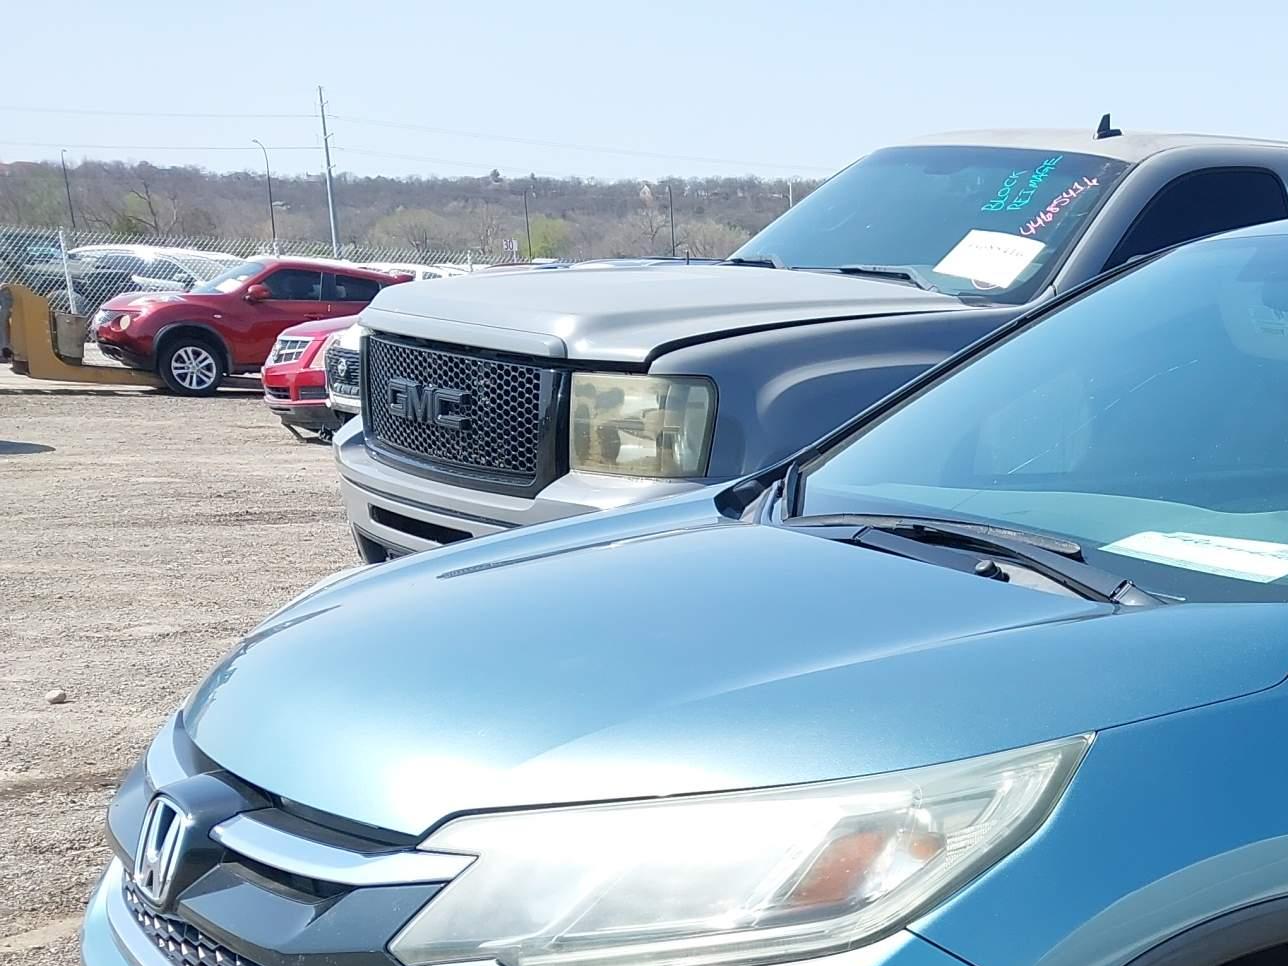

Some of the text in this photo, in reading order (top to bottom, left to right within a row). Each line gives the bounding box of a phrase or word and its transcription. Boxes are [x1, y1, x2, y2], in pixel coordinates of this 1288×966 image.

[981, 170, 1028, 212] BLOCK
[1006, 155, 1064, 211] REIMAGE
[503, 239, 514, 251] 30
[387, 376, 473, 431] GMC
